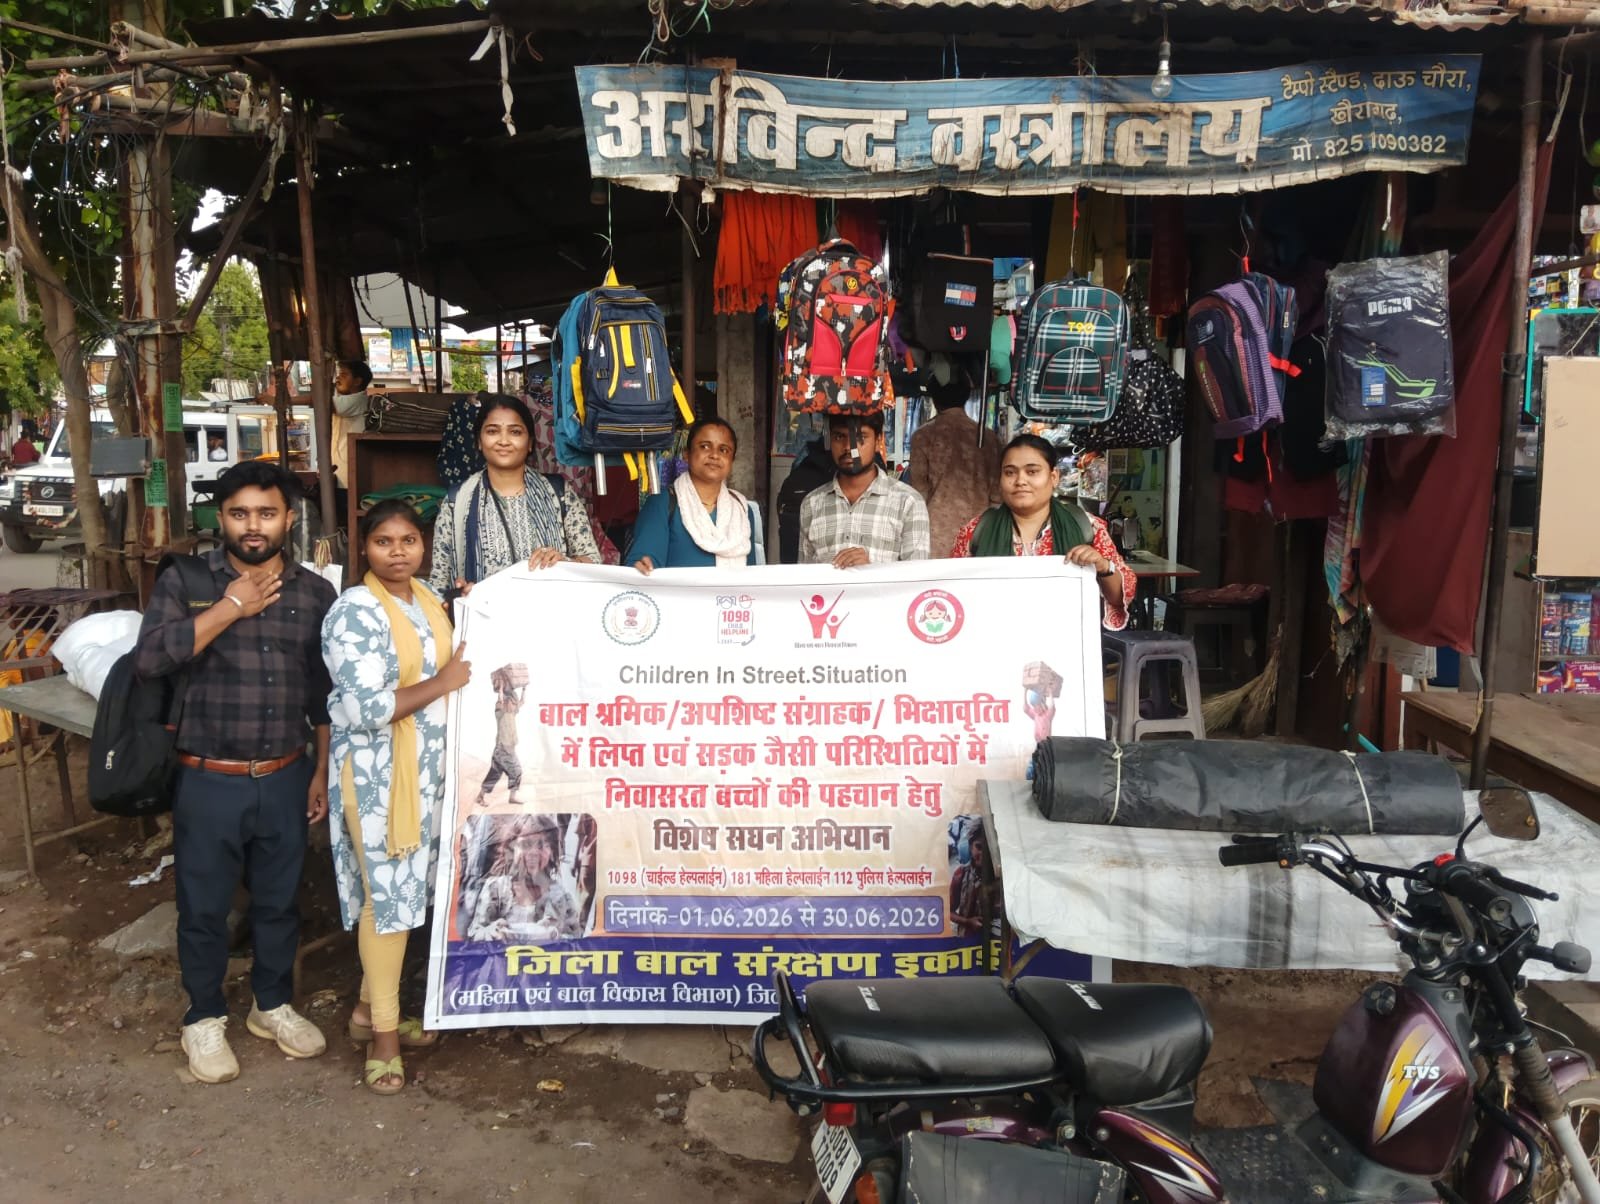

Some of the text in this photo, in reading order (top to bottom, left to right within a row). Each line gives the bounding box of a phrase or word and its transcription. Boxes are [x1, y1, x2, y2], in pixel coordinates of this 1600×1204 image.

[591, 75, 1273, 173] अरविन्द वस्त्रालय
[721, 610, 750, 623] 1098
[619, 664, 709, 684] Children
[716, 666, 735, 684] In
[539, 703, 589, 726] बाल
[783, 695, 885, 730] संग्राहक/
[893, 693, 1011, 731] भिक्षावृत्ति
[561, 734, 990, 774] में लिप्त एवं सड़क जैसी परिस्थितियों में
[605, 775, 943, 817] निवासरत बच्चों की पहचान हेतु
[653, 818, 892, 851] विशेष सघन अभियान
[608, 865, 932, 890] 1098 (चाईल्ड हेल्पलाईन) 181 महिला हेल्पलाईन 112 पुलिस हेल्पलाईन
[798, 901, 818, 928] से
[823, 907, 940, 928] 30.06.2026
[505, 945, 623, 976] जिला
[634, 951, 722, 976] बाल
[733, 946, 881, 977] संरक्षण
[450, 983, 519, 1010] (महिला
[525, 982, 552, 1005] एवं
[557, 986, 597, 1004] बाल
[602, 981, 667, 1003] विकास
[672, 983, 741, 1007] विभाग)
[1403, 1065, 1440, 1080] TVS
